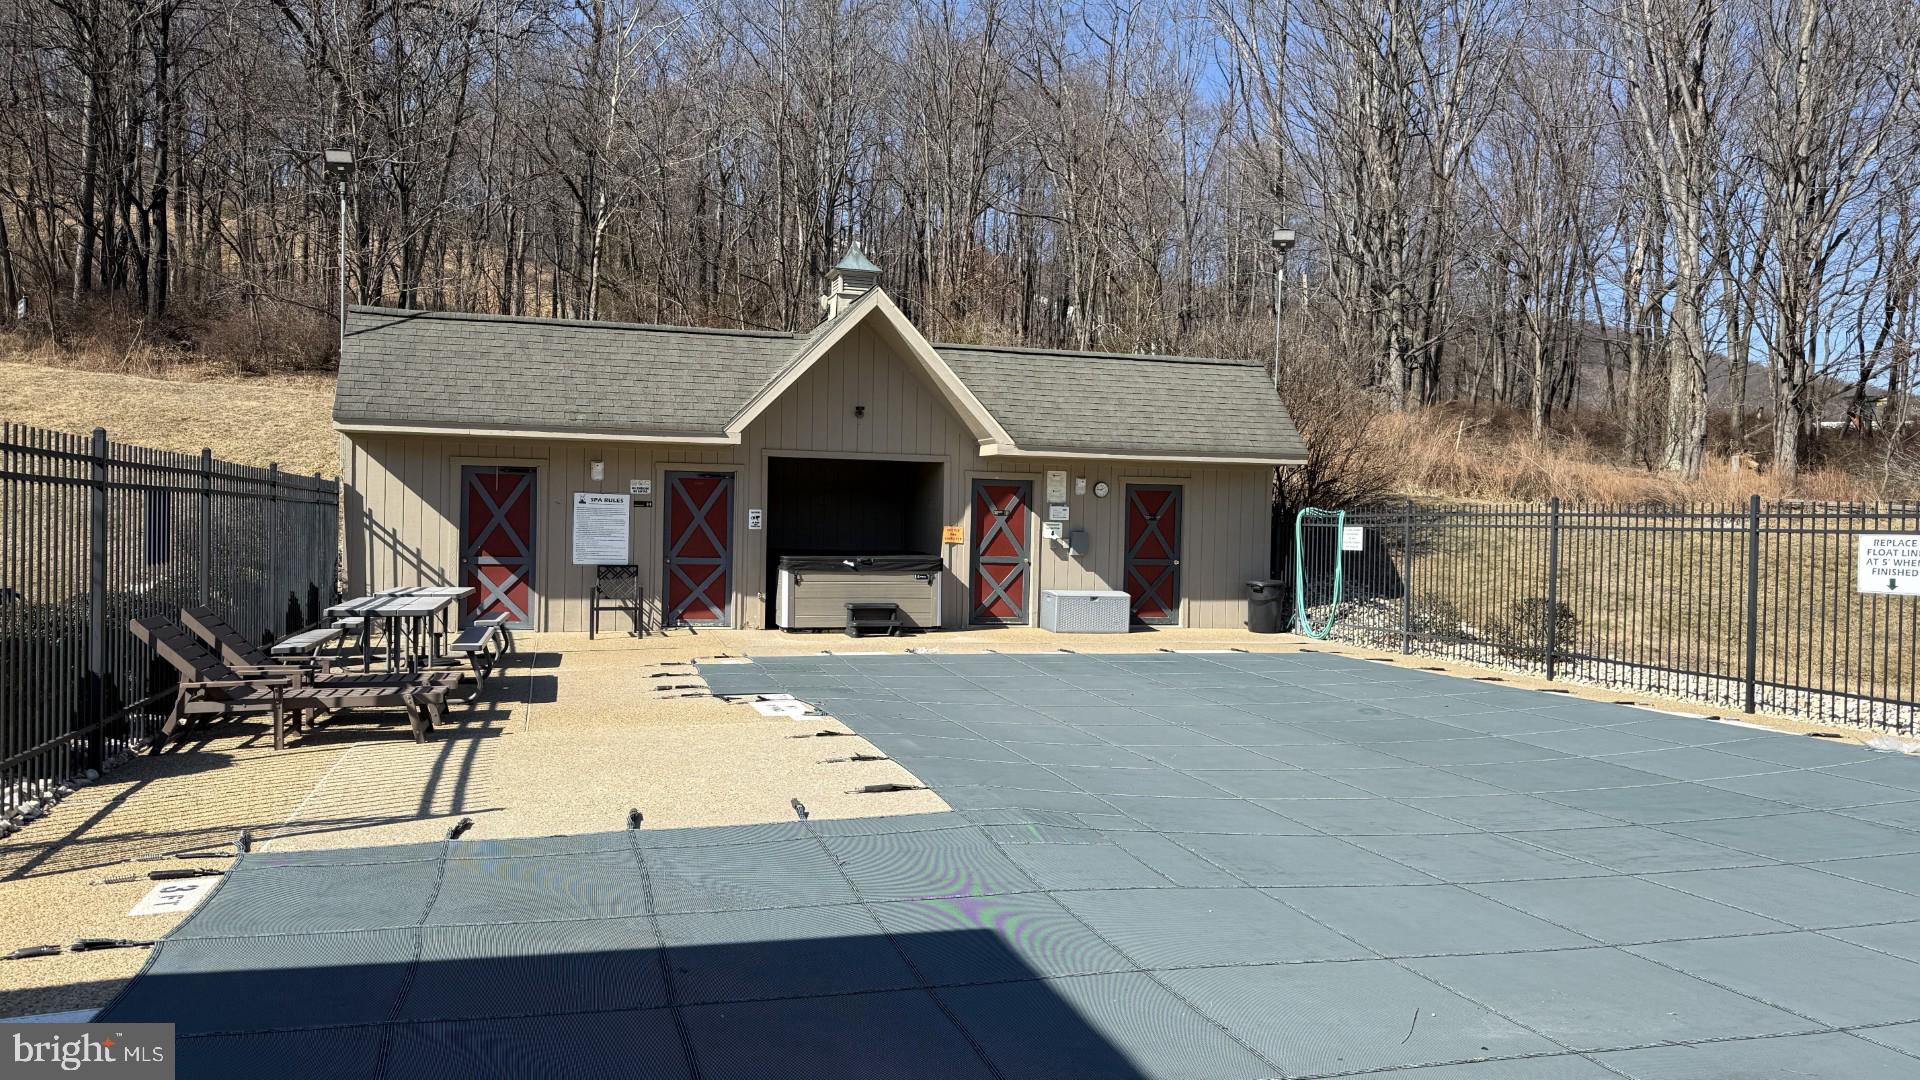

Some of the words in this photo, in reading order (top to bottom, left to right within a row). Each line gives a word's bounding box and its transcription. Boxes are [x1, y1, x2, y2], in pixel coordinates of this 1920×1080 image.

[1873, 539, 1918, 547] REPLACE
[1867, 548, 1899, 556] FLOAT
[1901, 549, 1920, 557] LIN
[1866, 558, 1879, 566] AT
[1871, 567, 1919, 577] FINISHED
[159, 884, 200, 893] 3
[153, 894, 185, 906] FT
